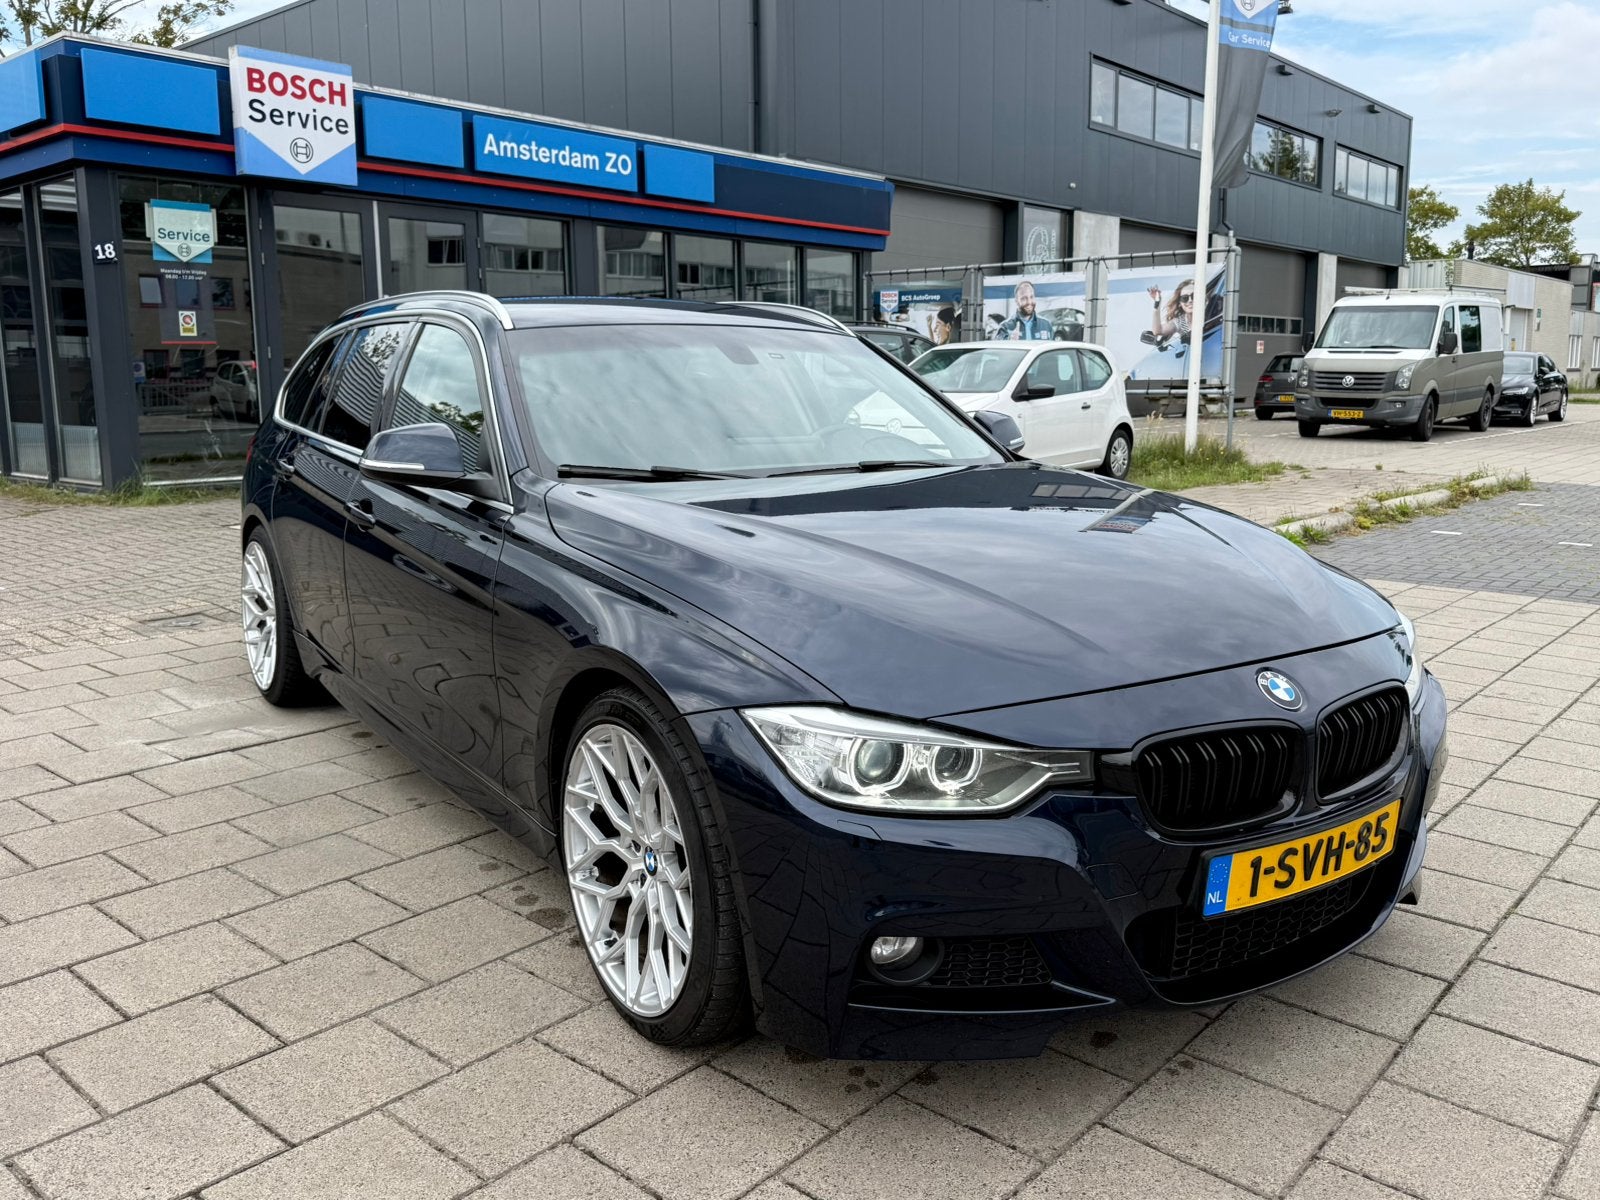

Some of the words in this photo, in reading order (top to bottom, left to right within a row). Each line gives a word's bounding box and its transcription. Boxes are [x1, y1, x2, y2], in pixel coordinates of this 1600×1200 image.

[1228, 31, 1239, 43] Car
[1241, 34, 1271, 48] Service
[246, 66, 347, 107] BOSCH
[248, 98, 349, 135] Service
[483, 132, 600, 171] Amsterdam
[604, 151, 632, 175] ZO
[157, 227, 211, 243] Service
[94, 243, 116, 260] 18
[1249, 811, 1390, 898] 1-SVH-85
[1207, 890, 1224, 905] NL
